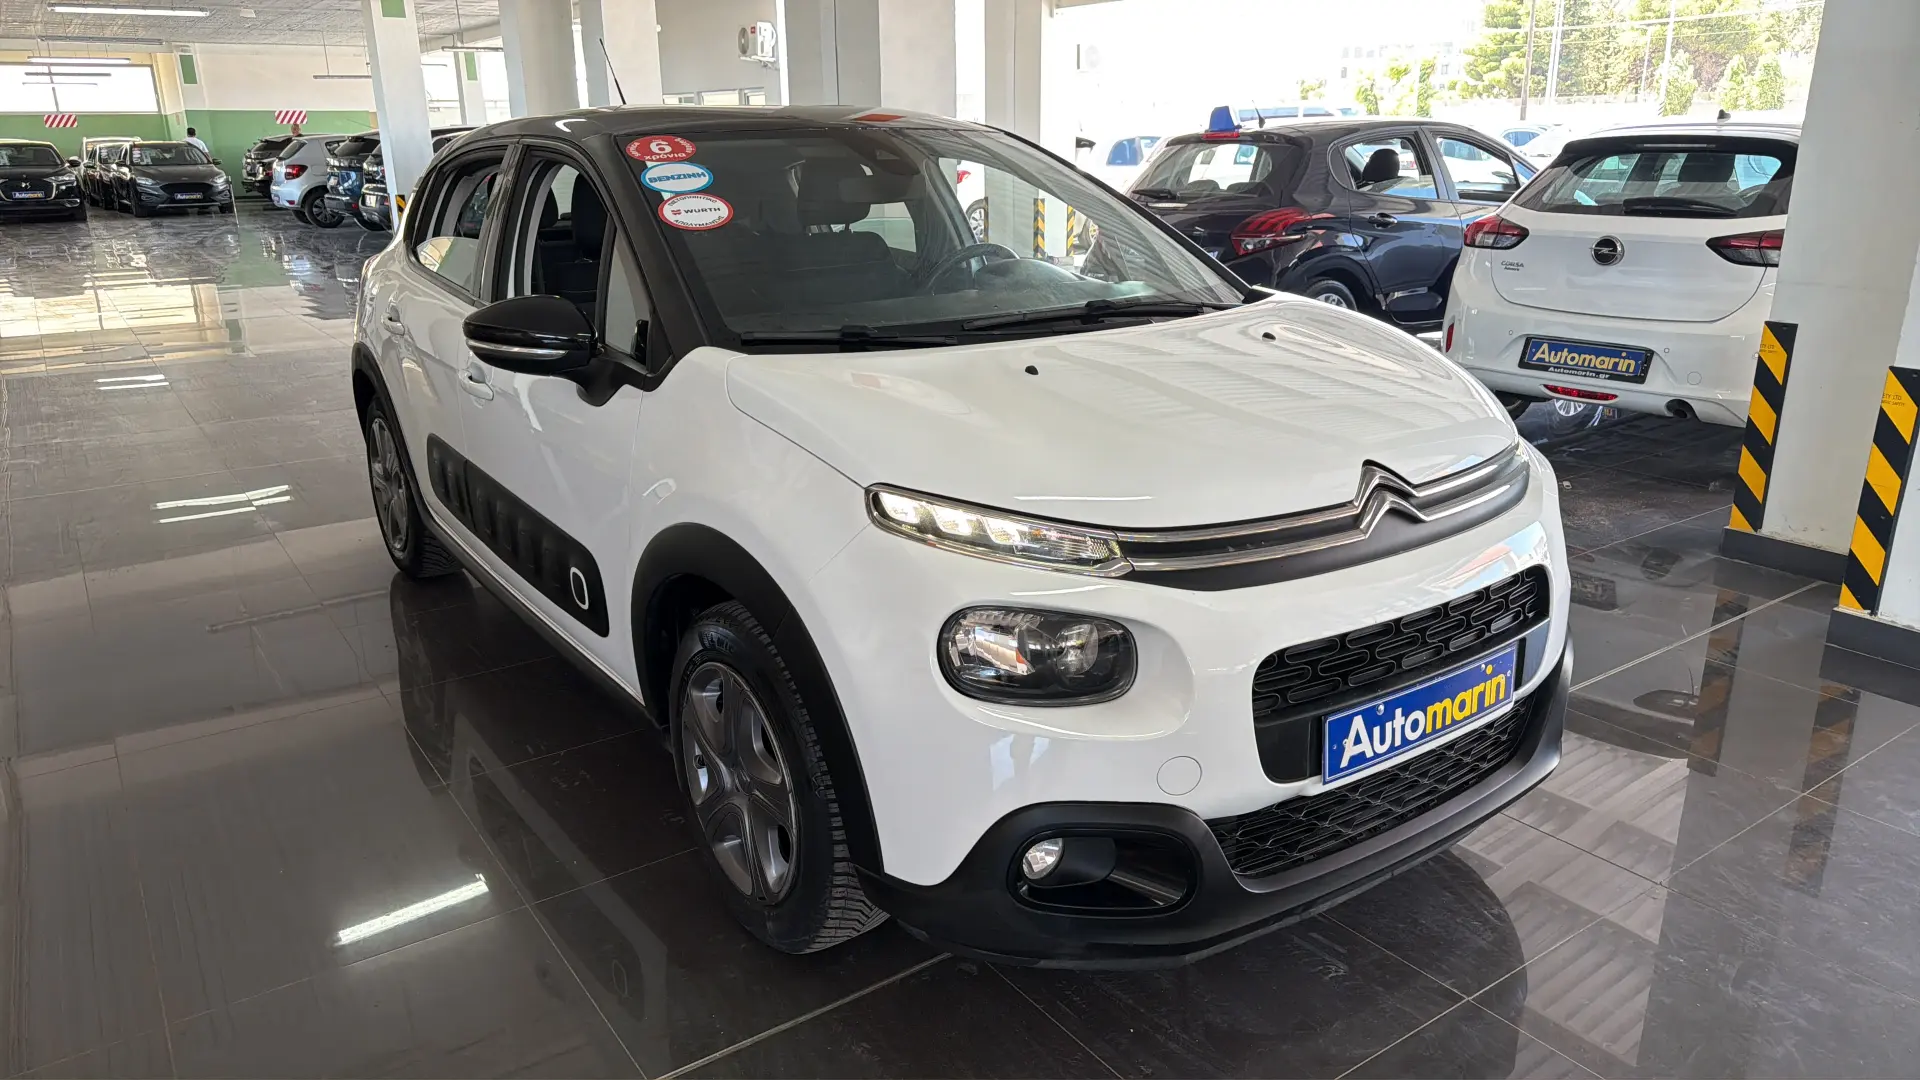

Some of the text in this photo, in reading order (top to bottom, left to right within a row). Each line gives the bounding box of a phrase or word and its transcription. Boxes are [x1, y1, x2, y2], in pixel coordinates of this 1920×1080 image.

[649, 140, 673, 154] 6
[644, 152, 686, 161] χρόνια
[648, 171, 707, 183] ΒΕΝΖΙΝΗ
[1501, 260, 1525, 268] CORSA
[1533, 343, 1636, 374] Automarin
[1547, 366, 1611, 380] Automarin.gr
[1340, 664, 1506, 769] Automarin
